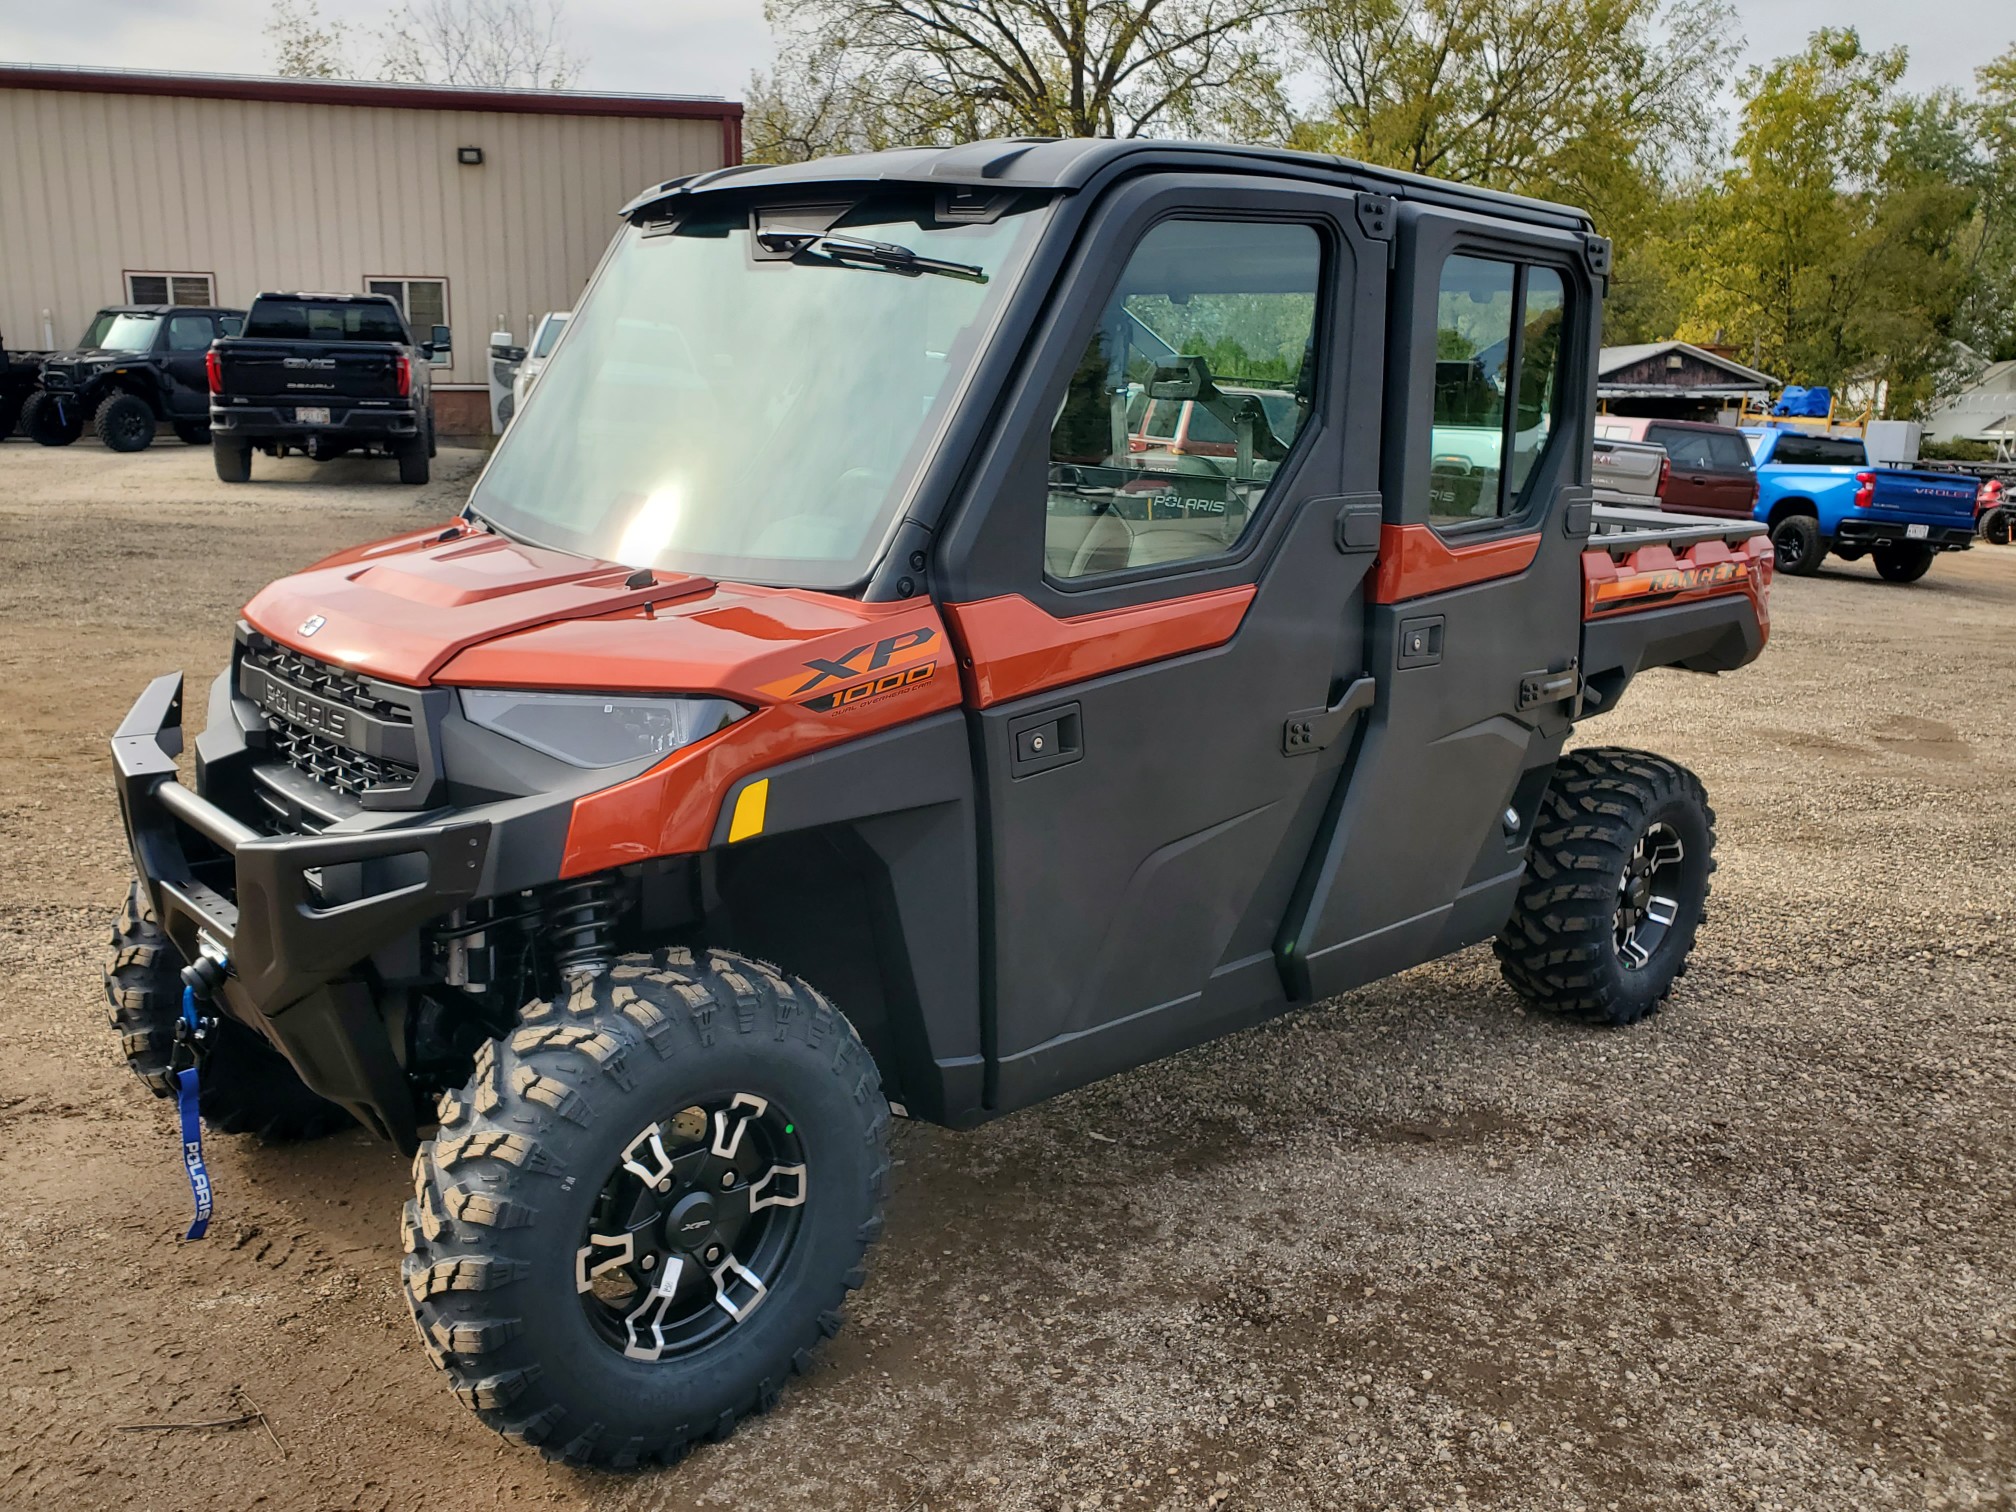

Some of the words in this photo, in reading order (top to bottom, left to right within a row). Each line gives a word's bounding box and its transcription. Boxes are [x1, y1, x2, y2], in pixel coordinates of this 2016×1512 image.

[284, 358, 336, 369] GMC
[1153, 495, 1226, 513] POLARIS
[1648, 562, 1741, 592] RANGER
[788, 627, 936, 696] XP
[831, 662, 936, 708] 1000
[265, 681, 346, 738] POLARIS
[185, 1141, 212, 1222] POLARIS
[680, 1220, 711, 1232] XP
